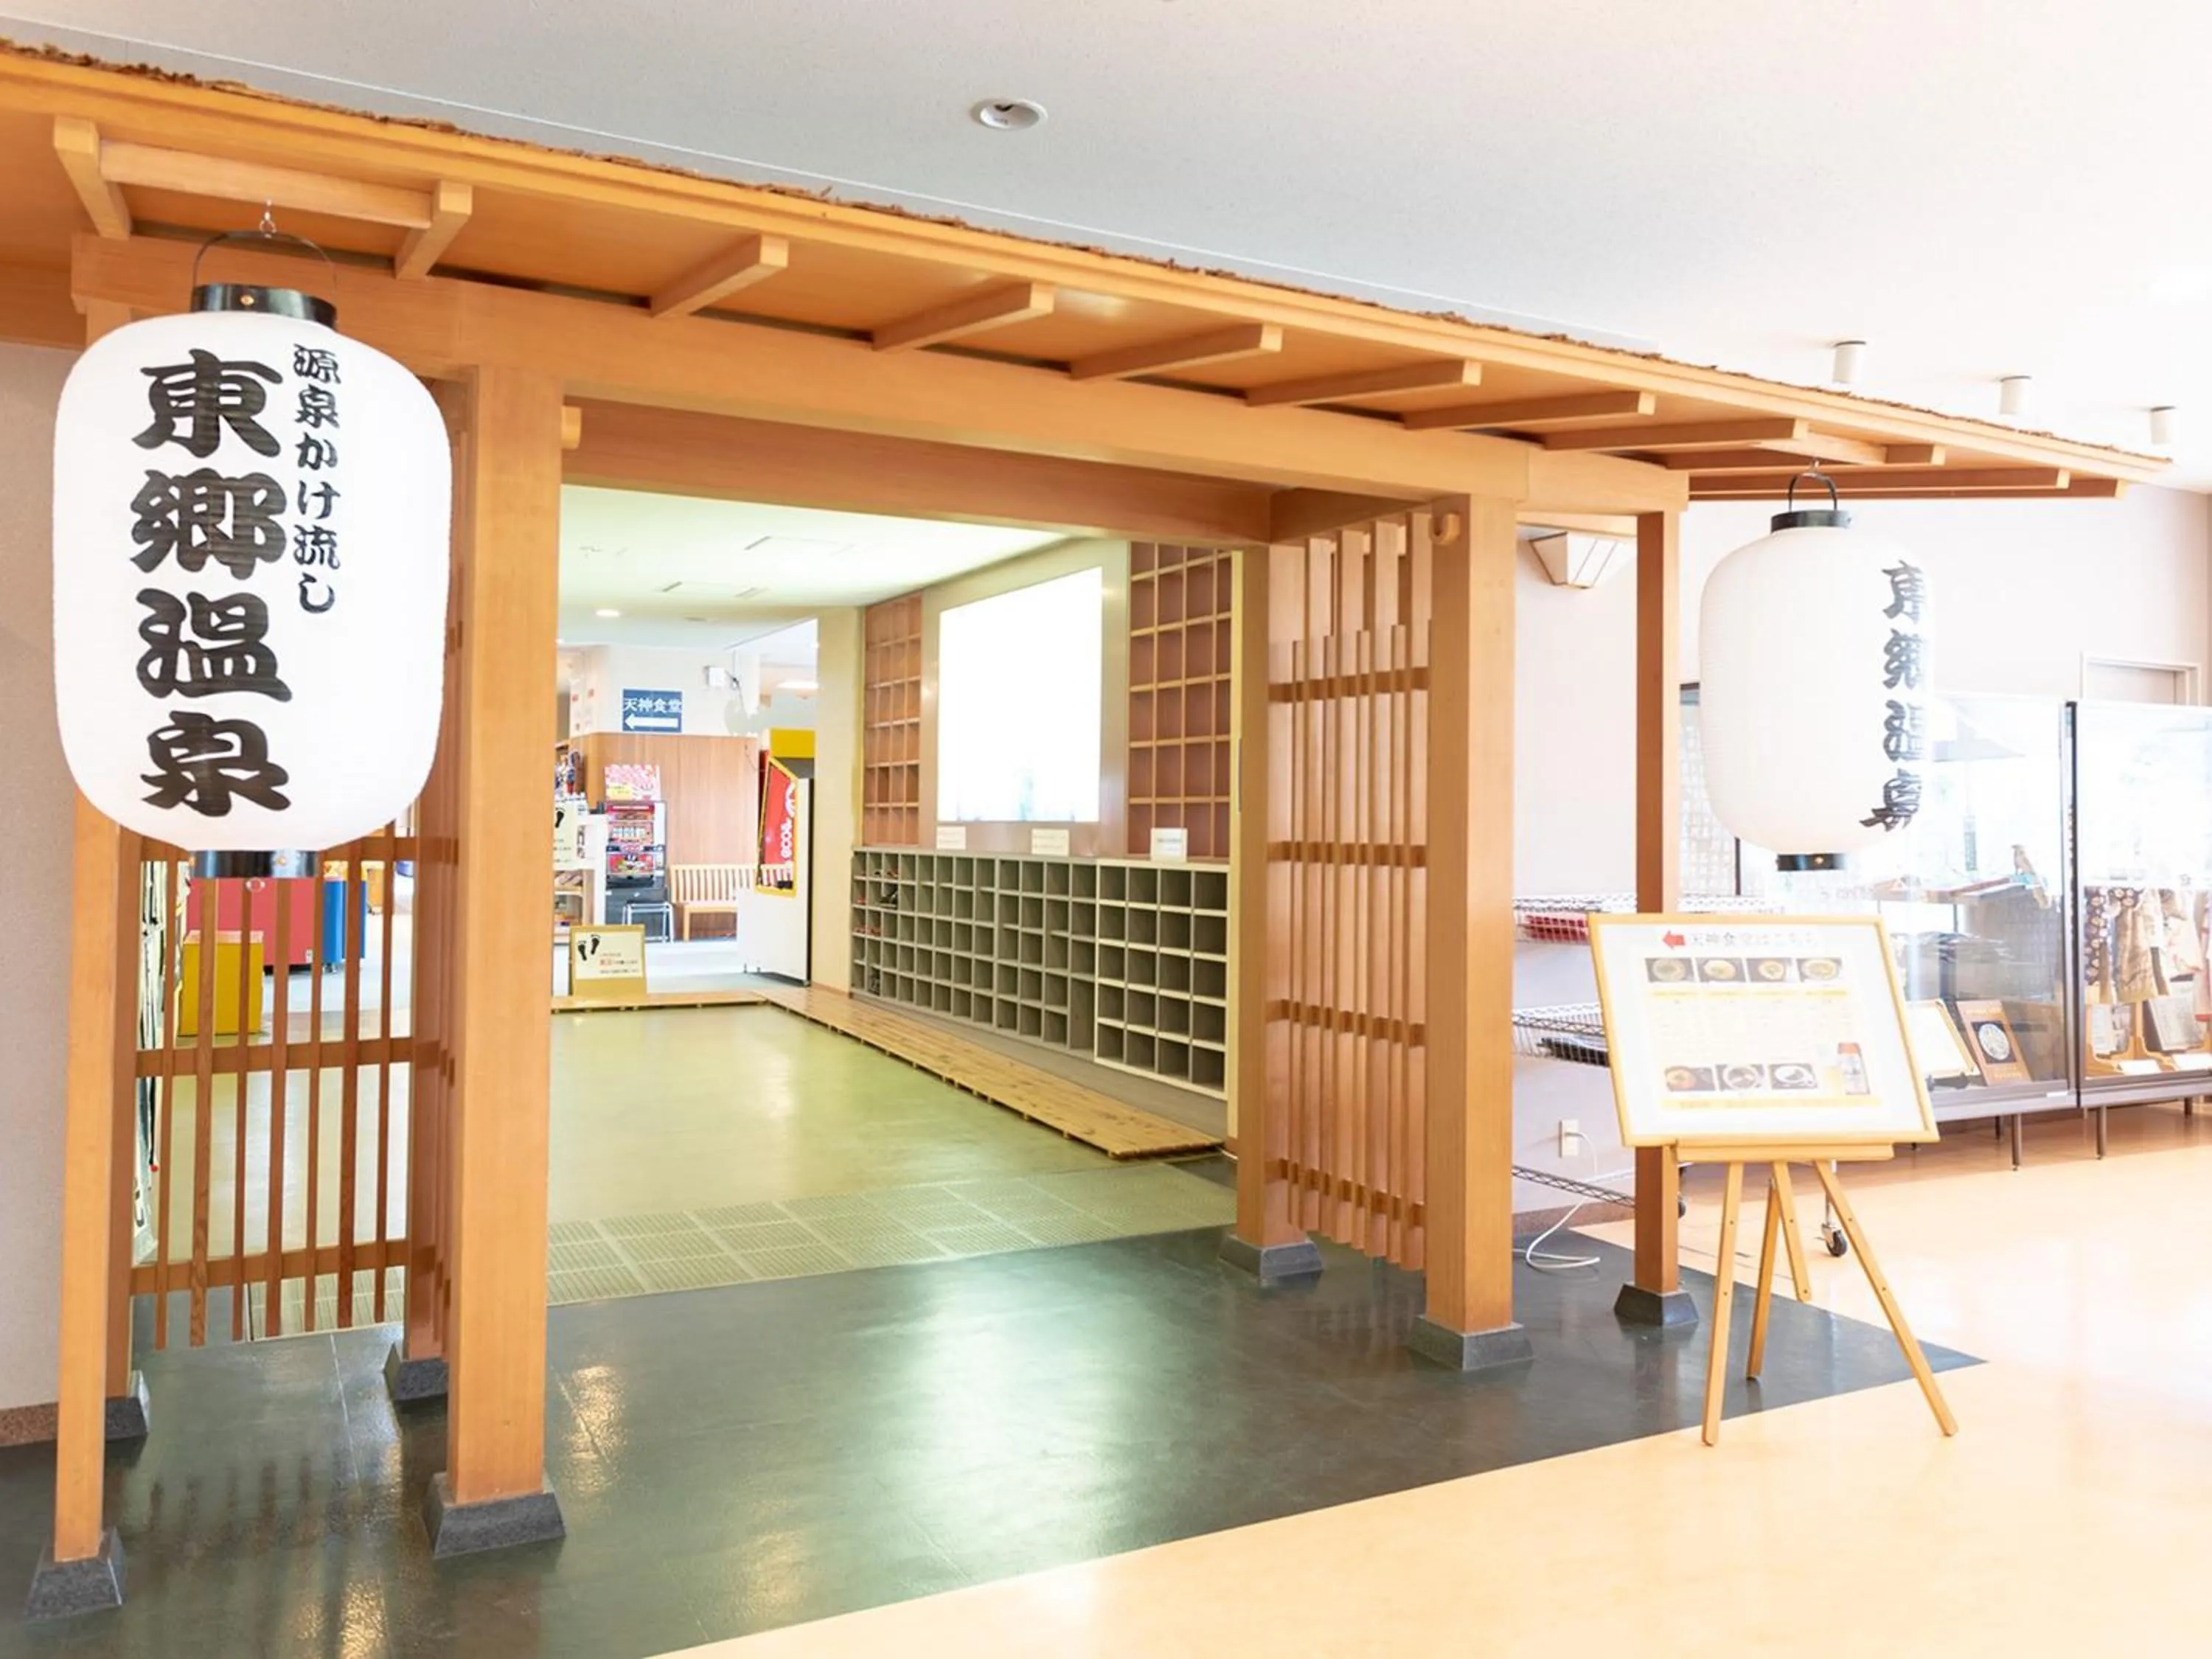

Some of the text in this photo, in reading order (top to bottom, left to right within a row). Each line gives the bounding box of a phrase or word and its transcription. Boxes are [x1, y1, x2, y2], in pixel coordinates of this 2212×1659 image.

[130, 349, 293, 817] 東郷温泉
[292, 344, 342, 613] 源泉かけ流し
[624, 697, 681, 713] 天神食堂
